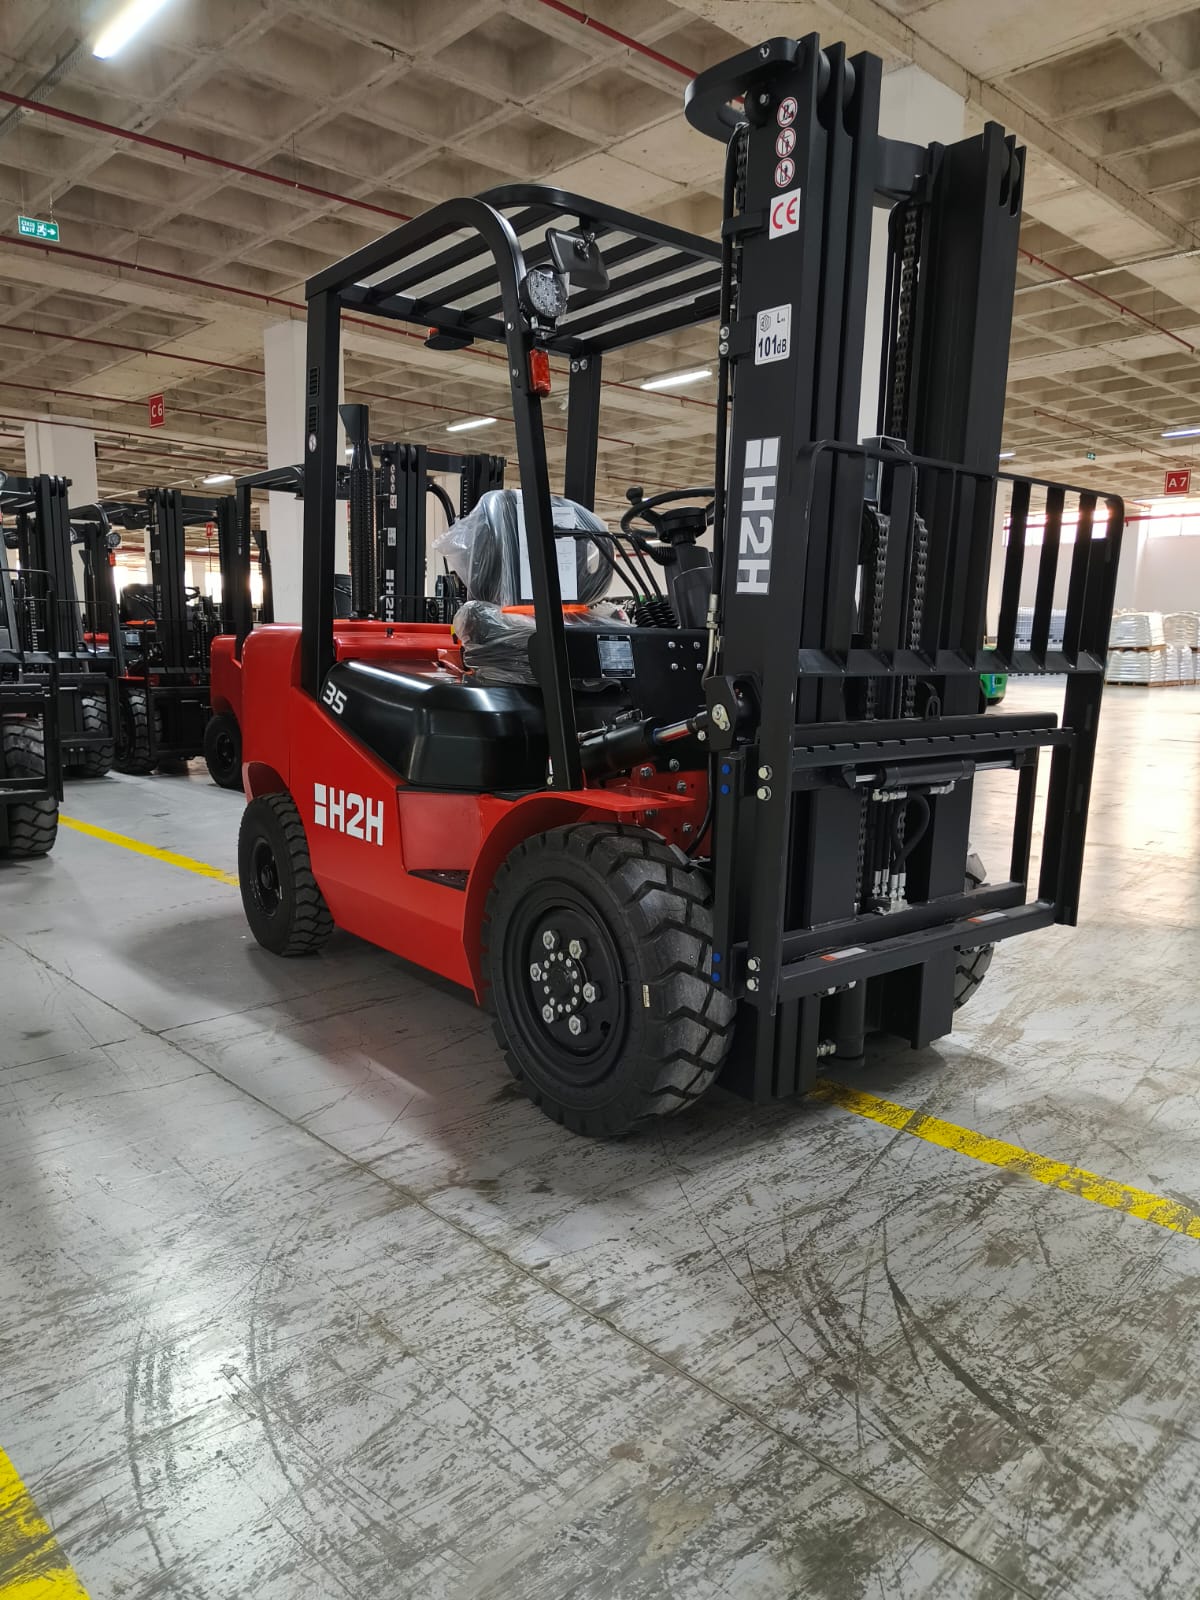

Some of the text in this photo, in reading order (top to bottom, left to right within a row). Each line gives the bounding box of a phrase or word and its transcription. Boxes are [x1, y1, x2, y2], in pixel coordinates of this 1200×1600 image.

[772, 196, 797, 230] CE
[736, 475, 776, 594] H2H
[385, 582, 395, 622] H2H
[322, 681, 348, 715] 35
[329, 786, 384, 847] H2H
